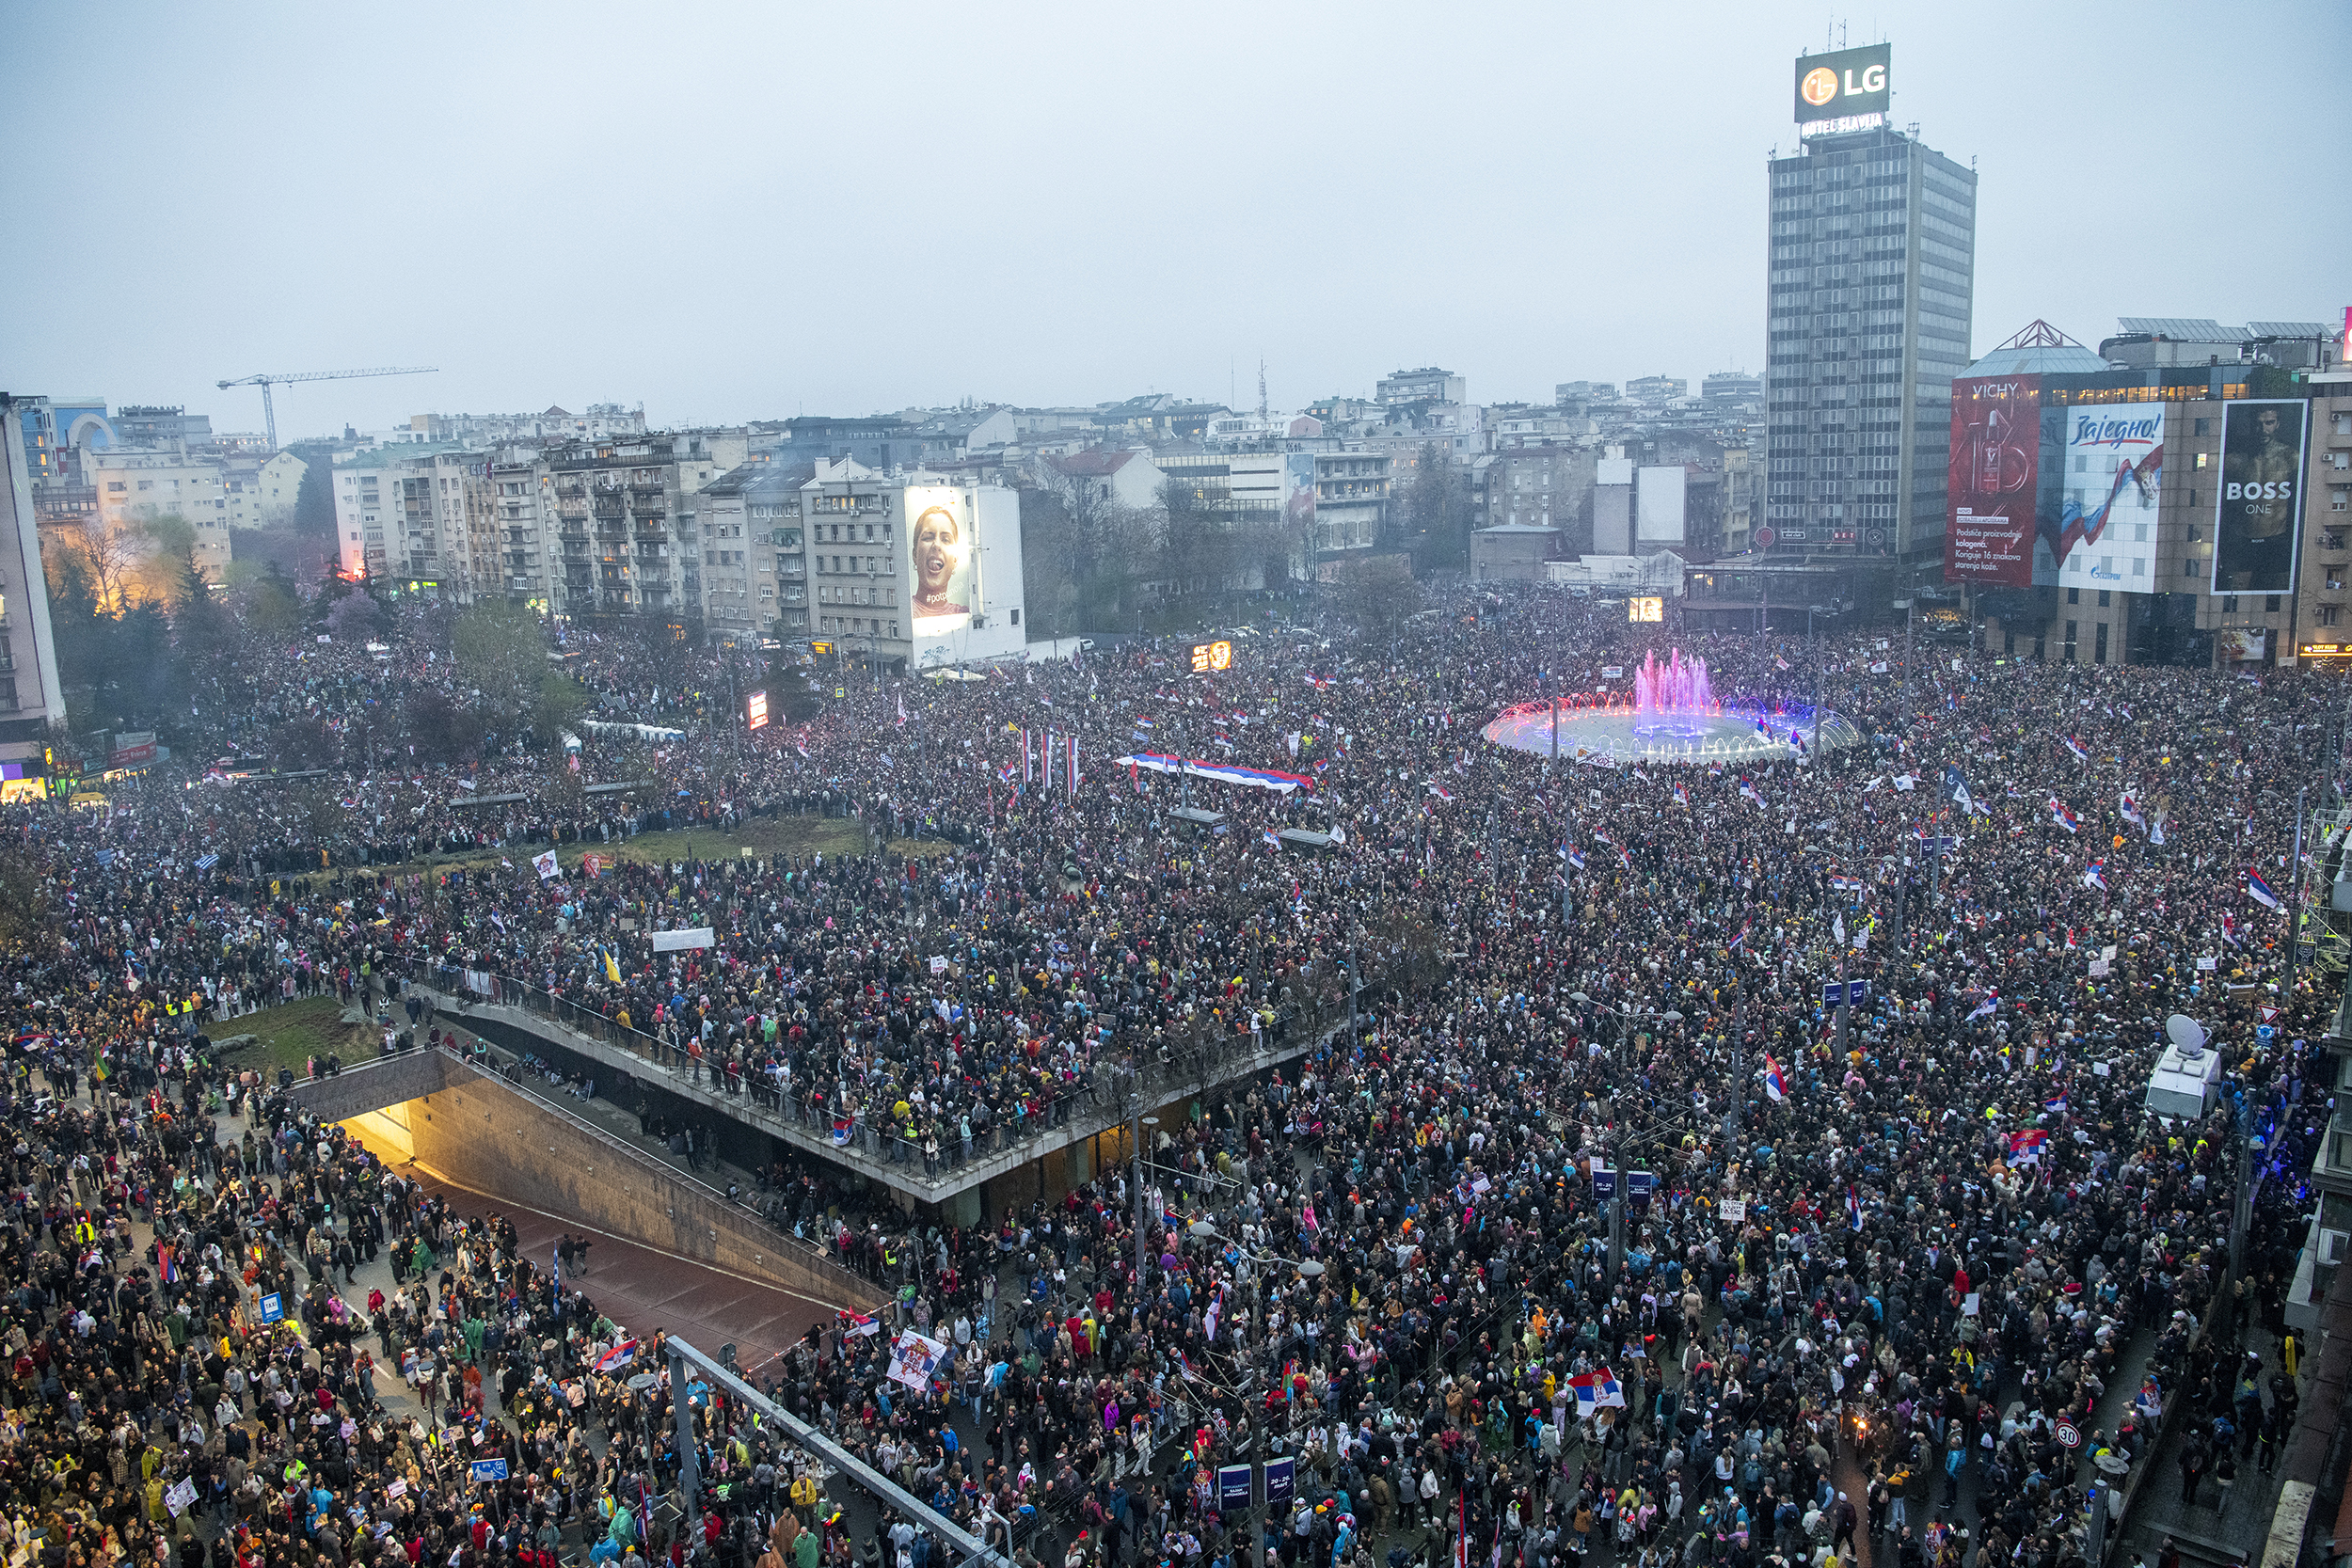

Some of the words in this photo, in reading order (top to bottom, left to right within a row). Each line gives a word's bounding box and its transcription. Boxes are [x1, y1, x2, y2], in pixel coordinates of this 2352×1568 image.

[1844, 64, 1885, 96] LG
[1802, 119, 1837, 136] HOTEL
[1838, 112, 1883, 131] SLAVIJA
[1973, 382, 2019, 398] VICHY
[2226, 481, 2292, 500] BOSS
[2245, 503, 2272, 515] ONE
[1956, 529, 1982, 537] Podstiče
[1982, 530, 2023, 539] proizvodnju
[1955, 539, 1987, 549] kolagena.
[1955, 550, 1982, 562] Koriguje
[1983, 551, 1992, 560] 16
[1992, 552, 2021, 562] znakova
[1955, 562, 1979, 572] starenja
[1980, 562, 1998, 571] kože.
[926, 580, 964, 604] #potpunoja
[265, 1301, 278, 1309] TAXI
[2059, 1428, 2075, 1443] 30
